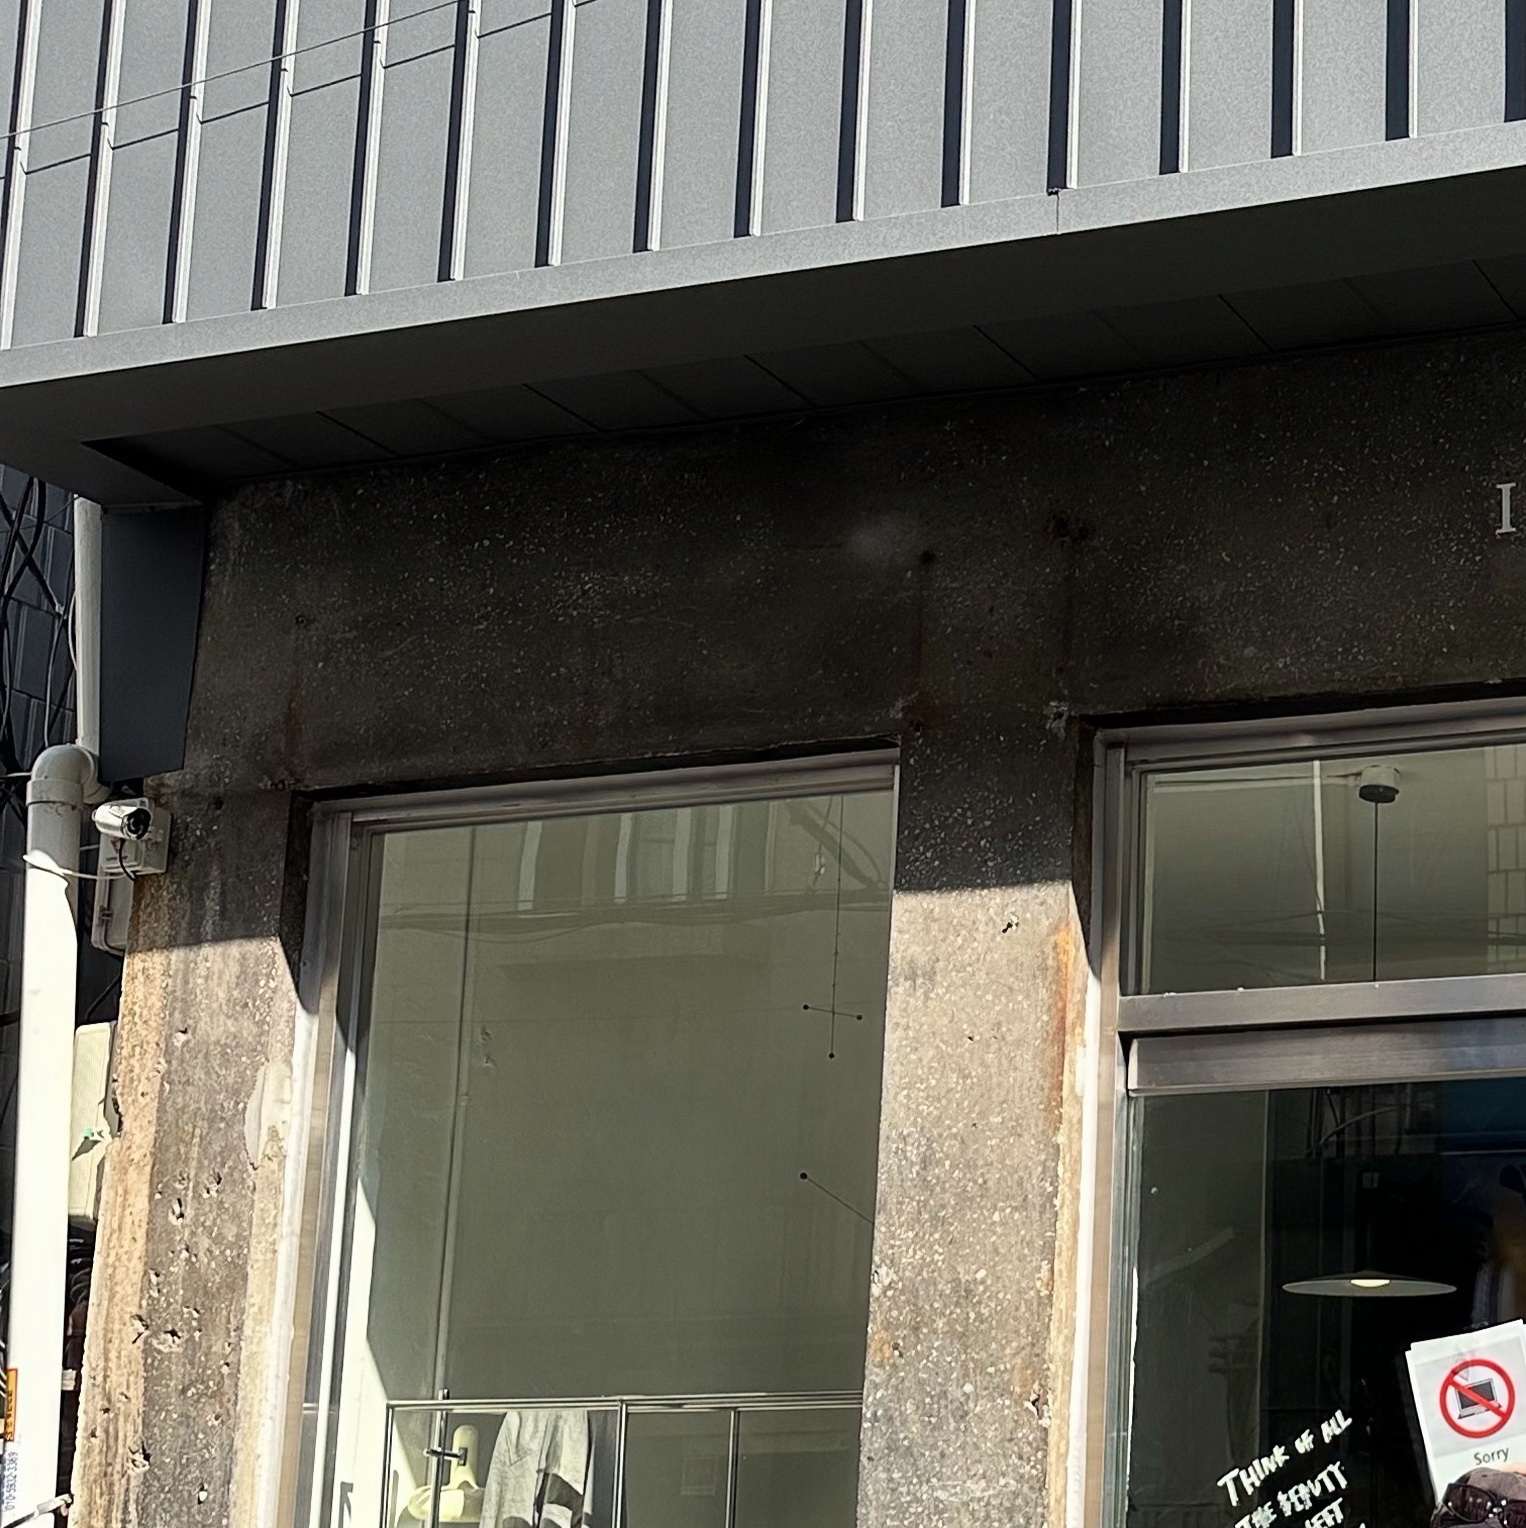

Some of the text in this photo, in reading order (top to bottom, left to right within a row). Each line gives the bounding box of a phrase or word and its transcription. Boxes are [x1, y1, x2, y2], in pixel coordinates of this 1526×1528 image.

[1496, 482, 1517, 535] I
[1217, 1410, 1352, 1507] THINK OF ALL
[1473, 1447, 1510, 1465] Sorry
